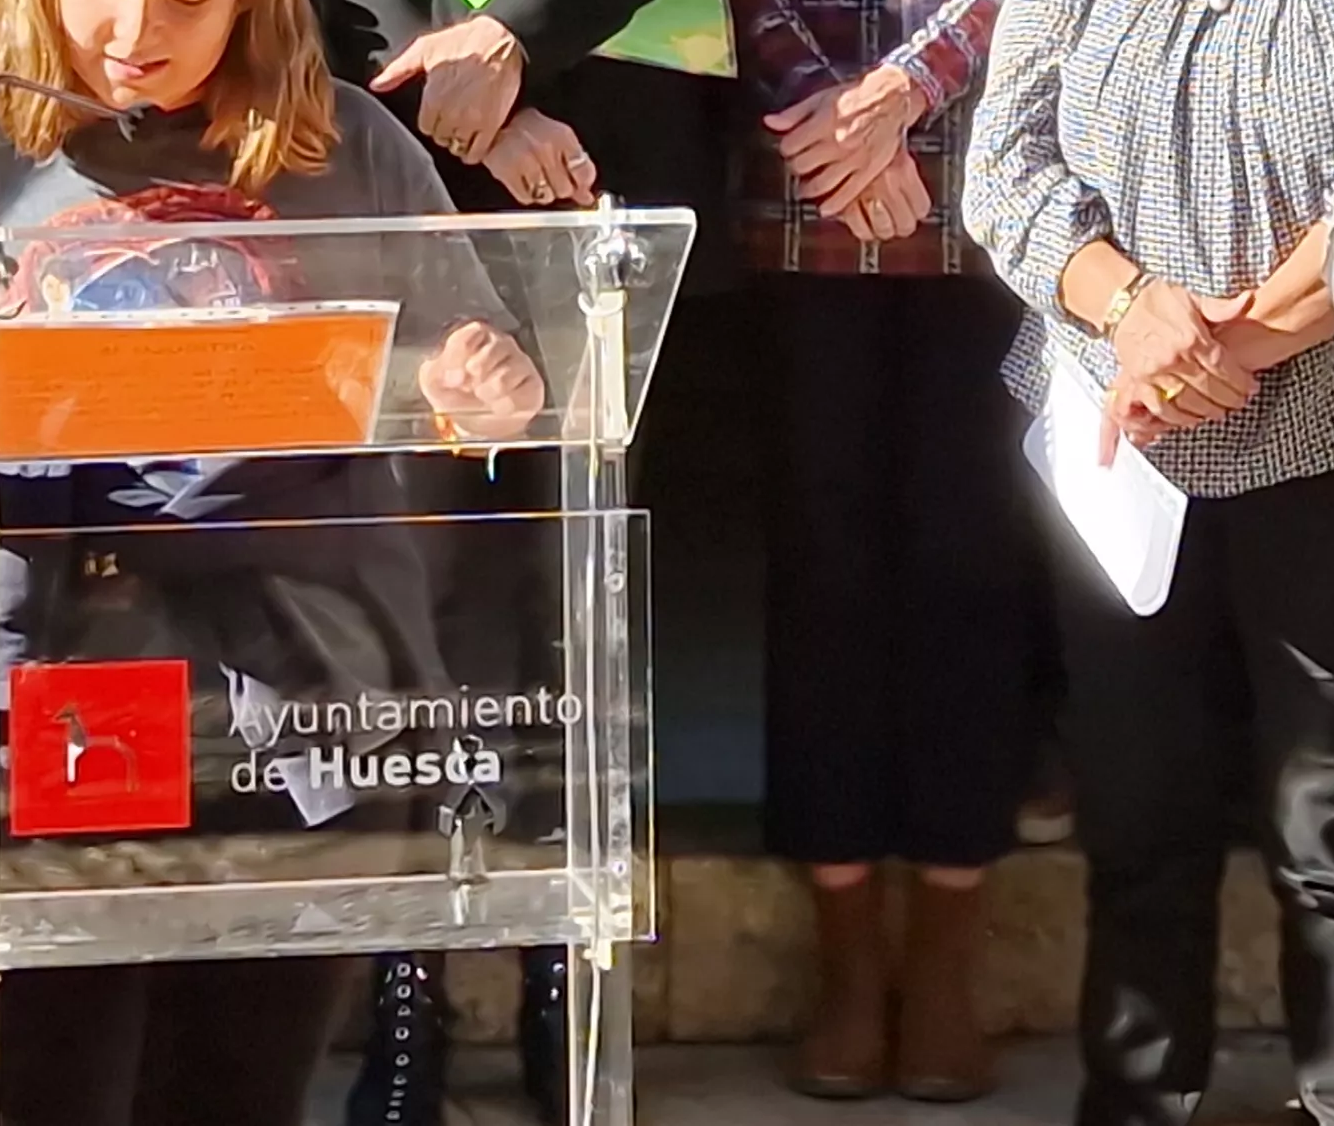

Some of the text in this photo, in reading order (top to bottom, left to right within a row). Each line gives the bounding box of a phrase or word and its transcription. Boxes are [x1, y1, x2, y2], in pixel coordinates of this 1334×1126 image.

[229, 684, 582, 749] Ayuntamiento
[231, 744, 501, 793] de Huesca
